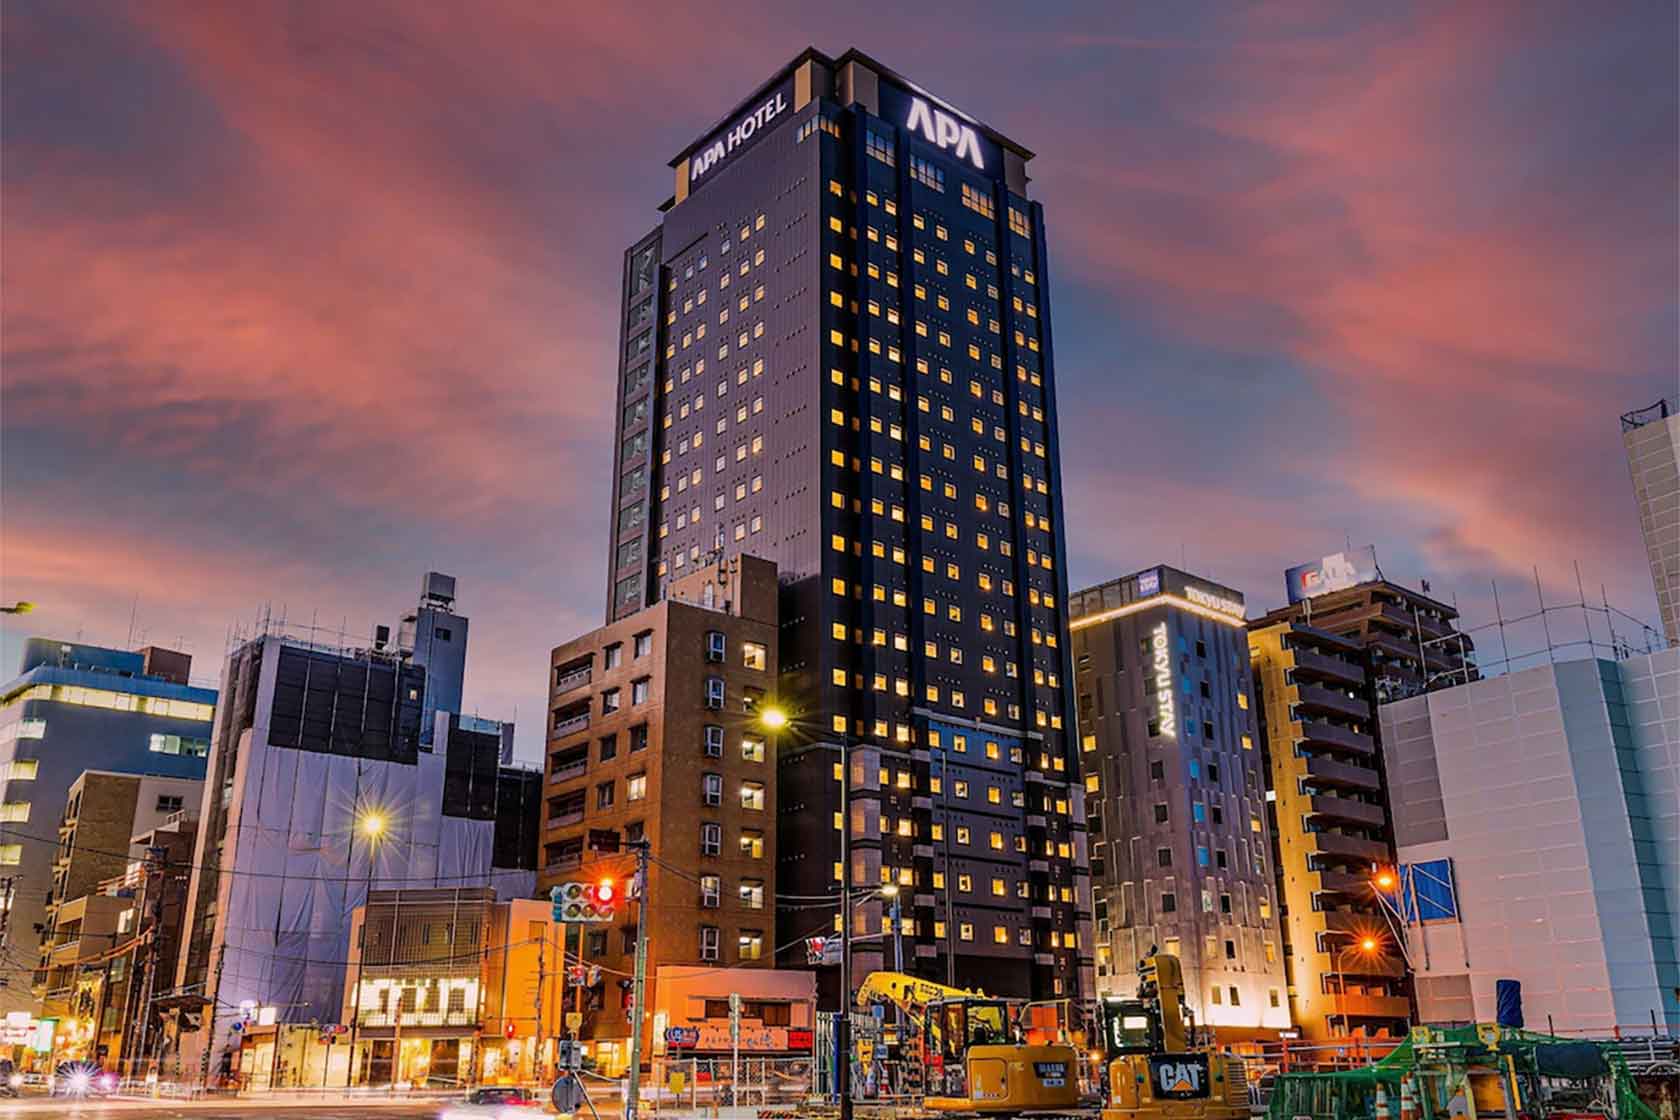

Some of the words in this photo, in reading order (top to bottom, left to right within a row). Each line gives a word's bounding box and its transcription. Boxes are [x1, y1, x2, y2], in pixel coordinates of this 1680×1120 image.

[691, 141, 725, 180] APA
[727, 93, 787, 152] HOTEL
[906, 97, 984, 170] APA
[1153, 621, 1171, 687] TOKYU
[1158, 689, 1176, 738] STAY
[1159, 1062, 1201, 1091] CAT
